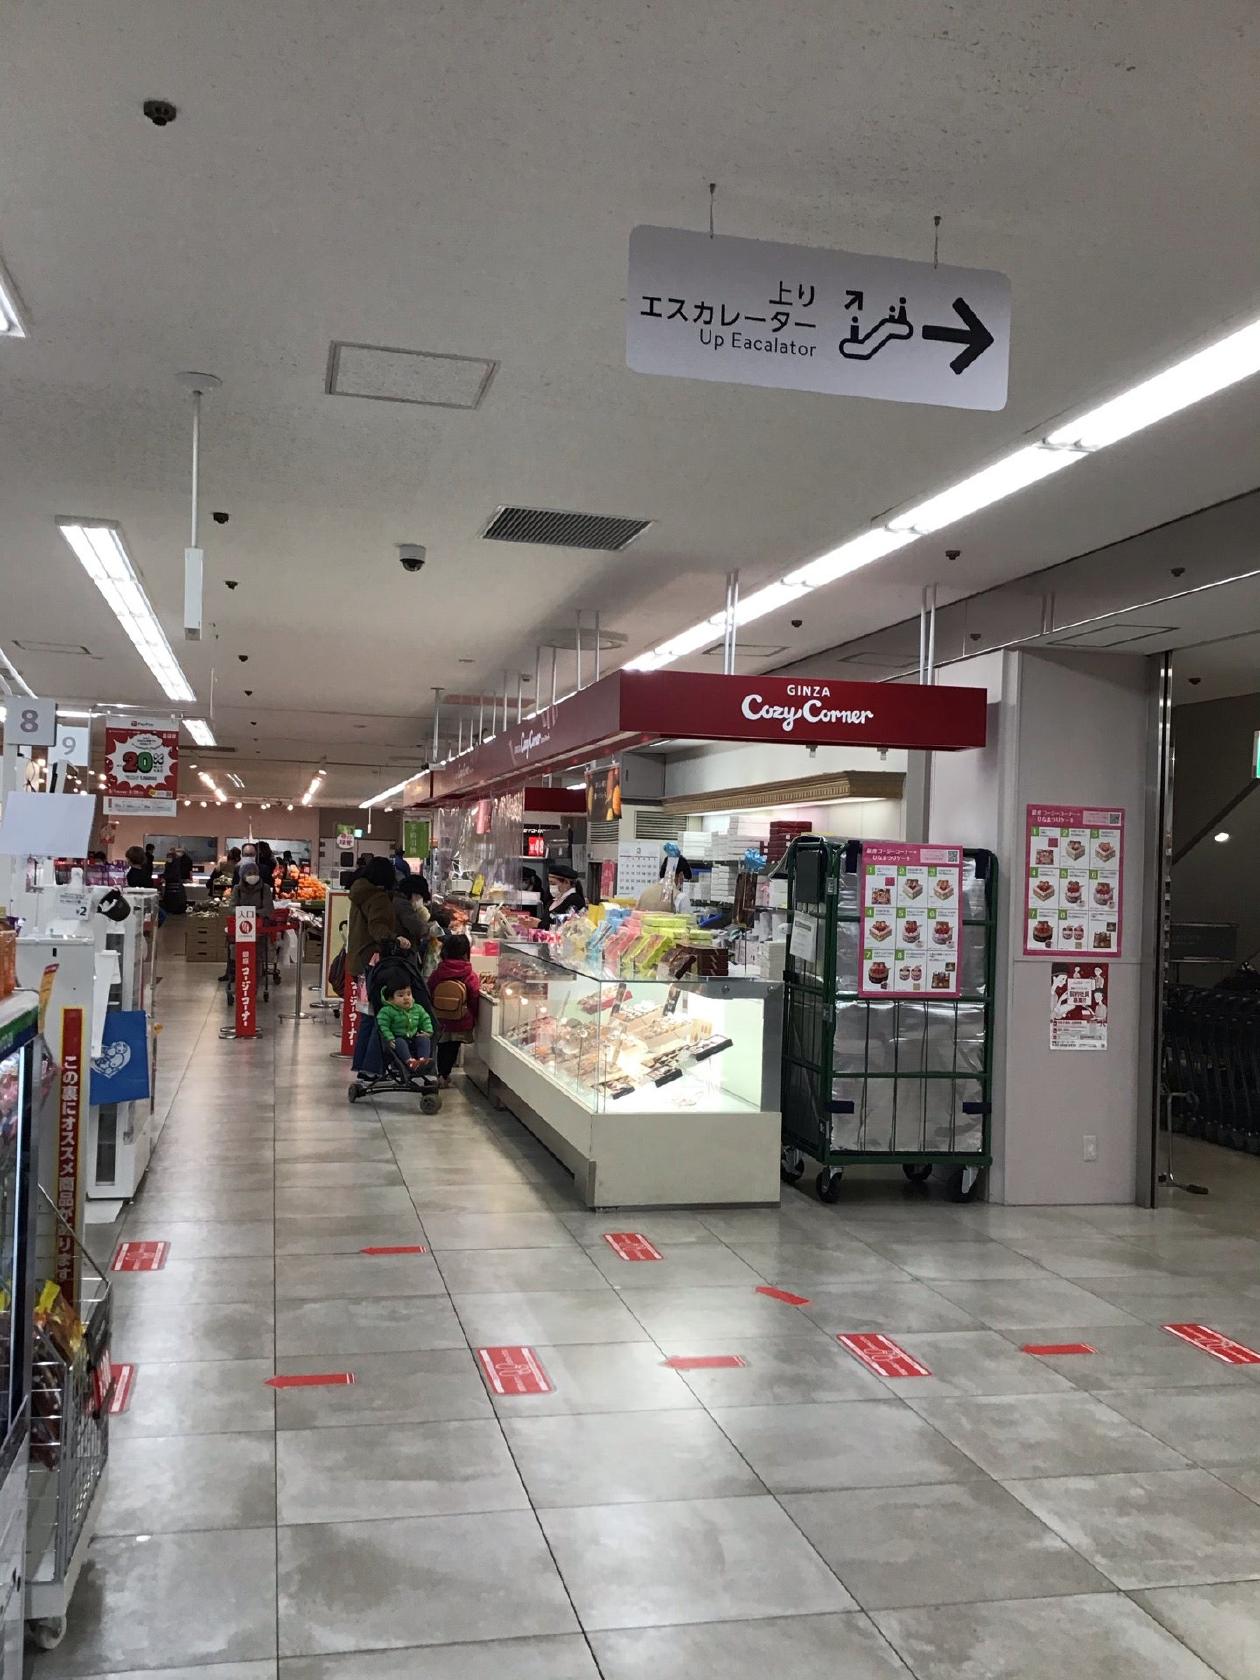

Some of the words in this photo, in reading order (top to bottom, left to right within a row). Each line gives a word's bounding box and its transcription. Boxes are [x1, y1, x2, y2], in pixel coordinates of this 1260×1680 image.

[769, 281, 815, 307] 上り
[640, 295, 816, 332] エスカレーター
[700, 329, 725, 351] Up
[732, 332, 816, 357] Eacalator
[786, 684, 831, 697] GINZA
[20, 709, 39, 733] 8
[741, 694, 802, 731] Cozy
[802, 700, 874, 724] Corner
[62, 736, 76, 755] 9
[239, 910, 254, 919] 入口
